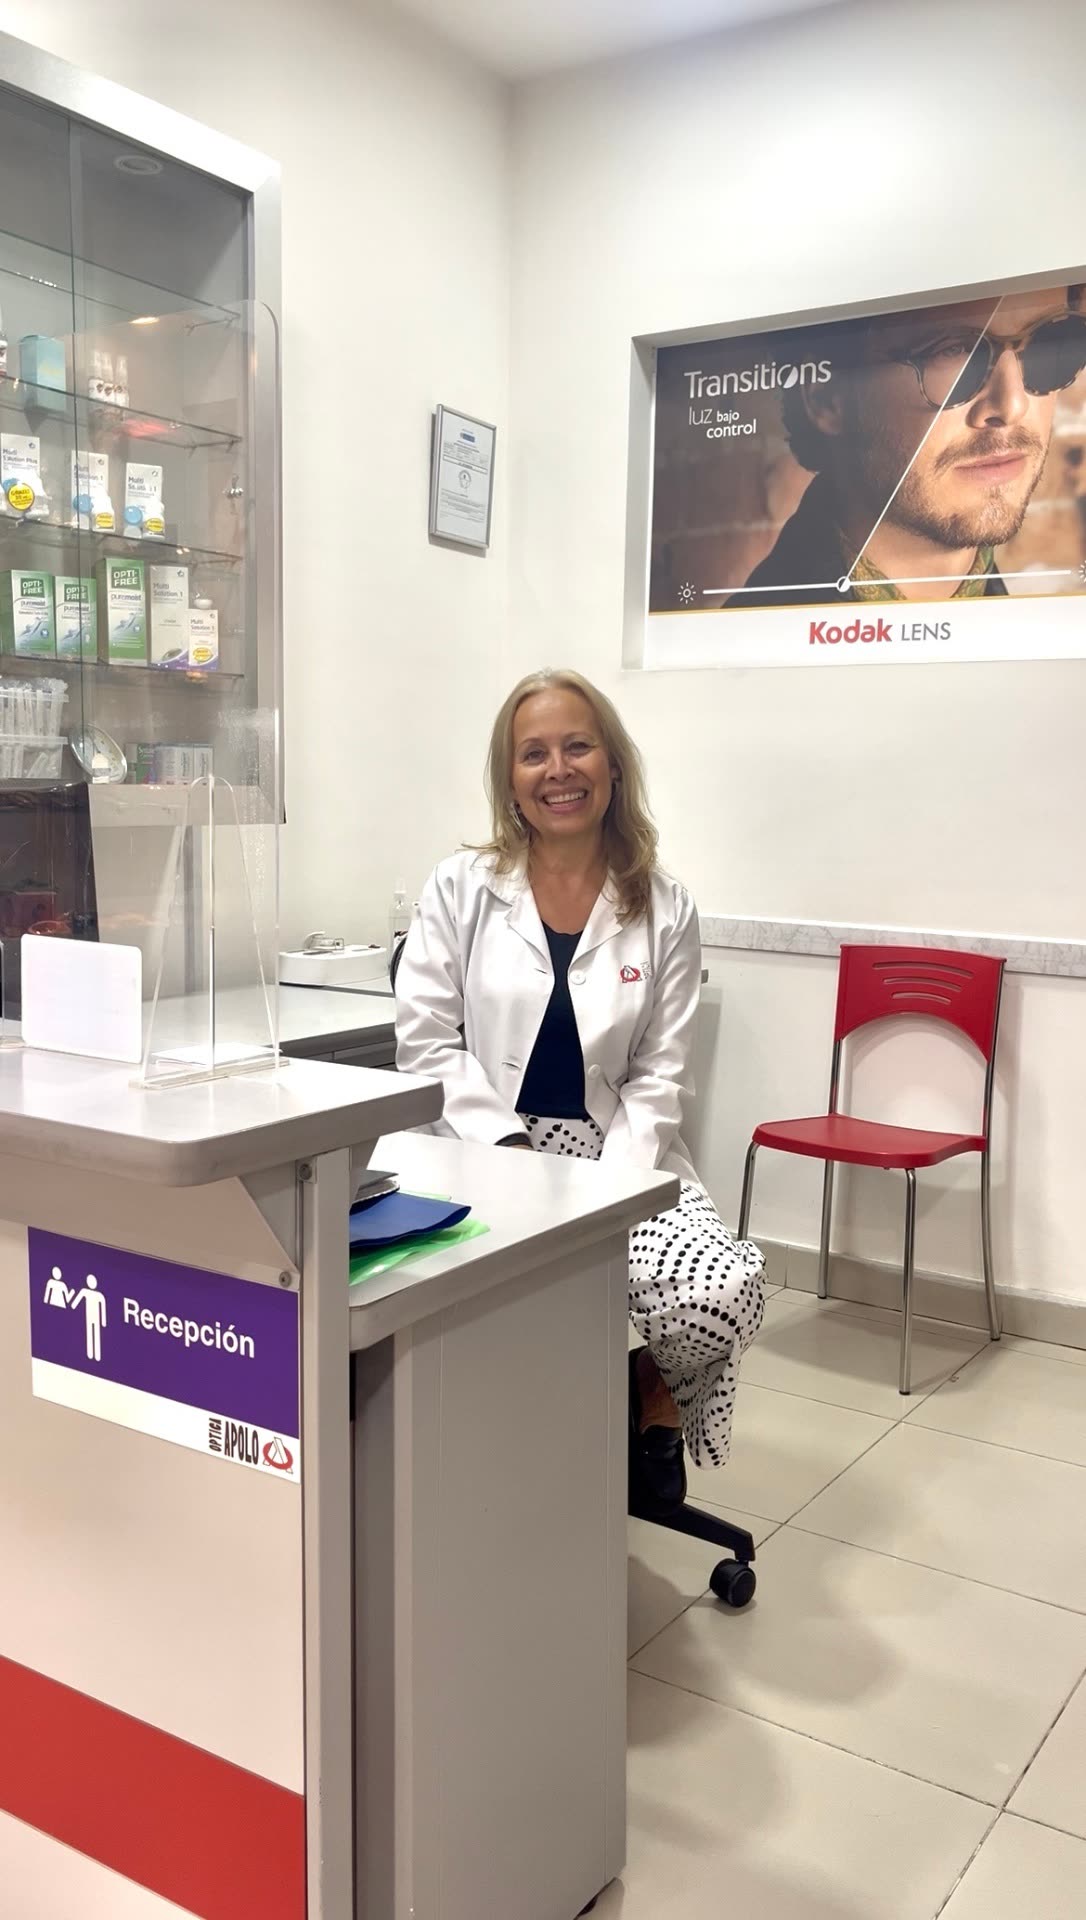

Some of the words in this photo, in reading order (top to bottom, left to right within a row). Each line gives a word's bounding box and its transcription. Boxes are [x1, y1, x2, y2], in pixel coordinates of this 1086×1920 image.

[684, 358, 832, 400] Transitions
[688, 405, 713, 427] luz
[716, 409, 740, 425] bajo
[706, 420, 757, 439] control
[114, 578, 138, 586] FREE
[808, 618, 893, 645] Kodak
[901, 622, 951, 642] LENS
[123, 1297, 256, 1359] Recepción
[209, 1417, 222, 1452] OPTICA
[224, 1421, 259, 1466] APOLO
